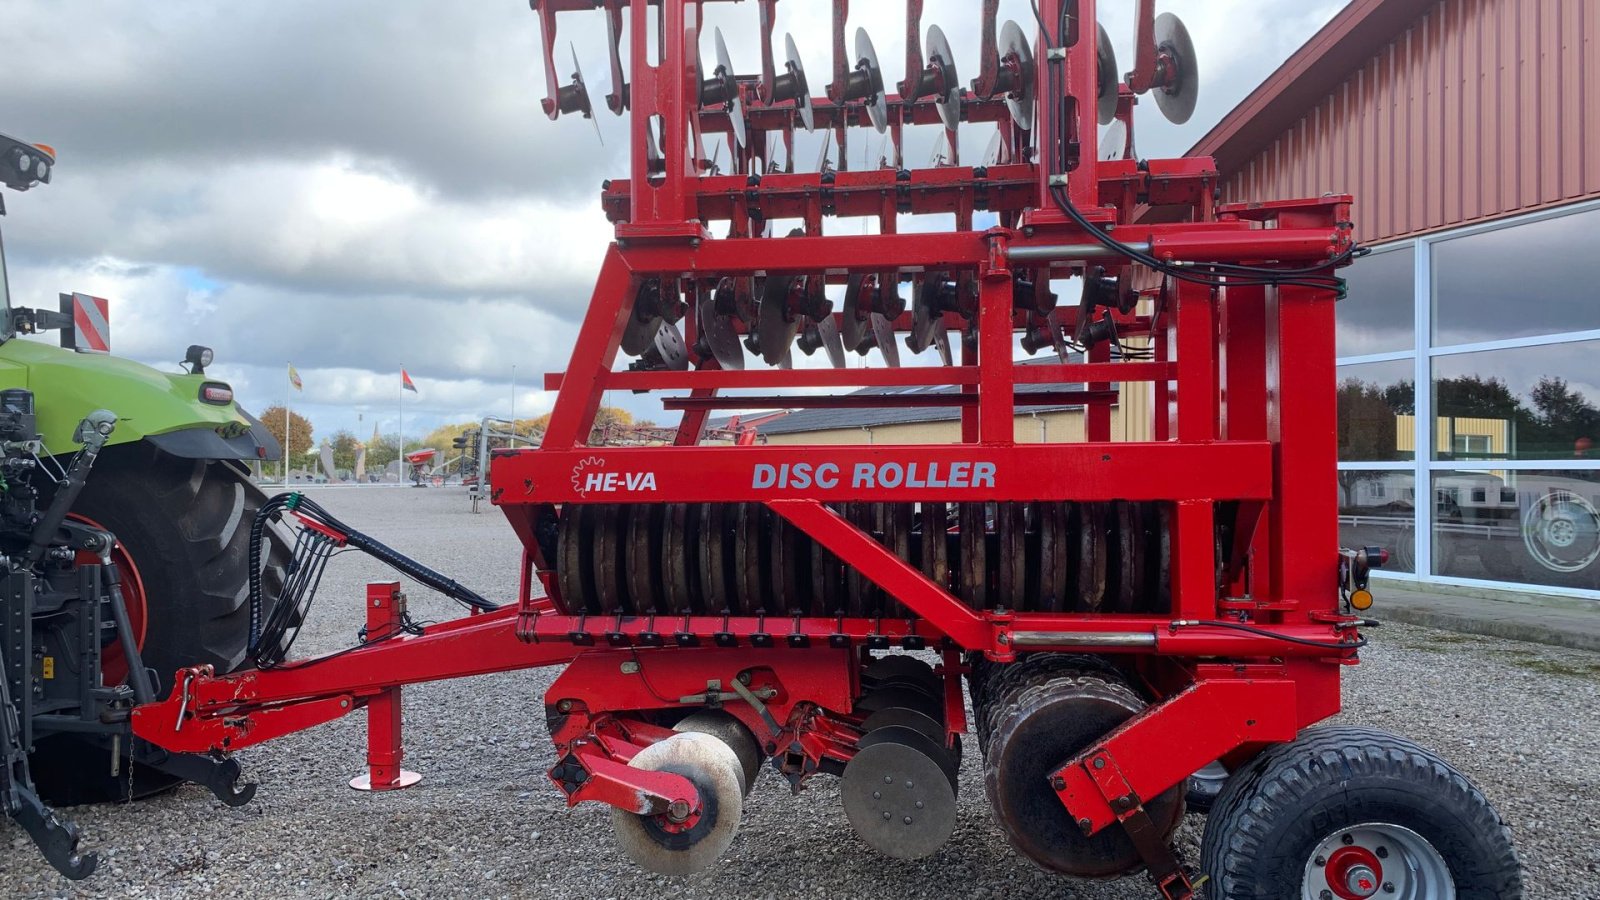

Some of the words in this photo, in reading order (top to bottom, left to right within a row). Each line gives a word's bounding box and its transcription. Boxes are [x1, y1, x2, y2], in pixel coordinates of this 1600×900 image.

[585, 472, 657, 492] HE-VA
[752, 462, 840, 489] DISC
[852, 461, 997, 489] ROLLER
